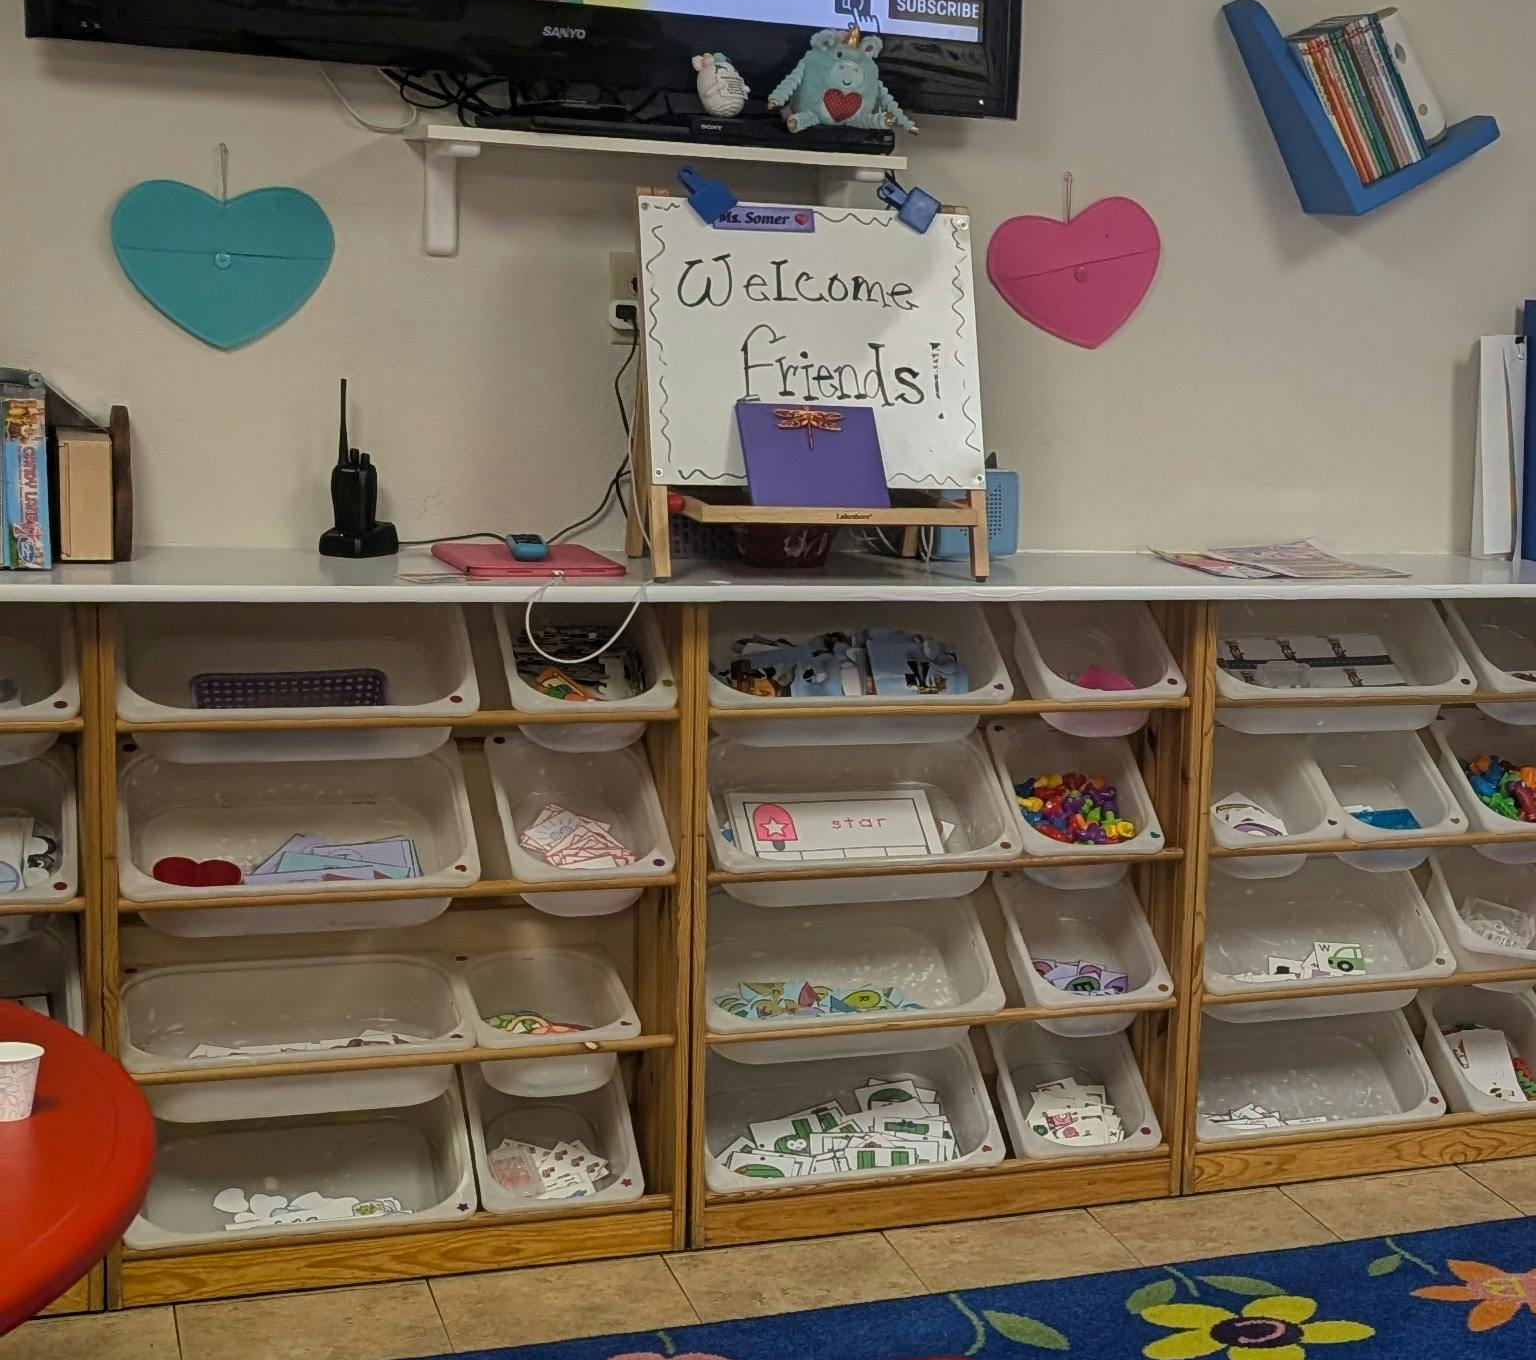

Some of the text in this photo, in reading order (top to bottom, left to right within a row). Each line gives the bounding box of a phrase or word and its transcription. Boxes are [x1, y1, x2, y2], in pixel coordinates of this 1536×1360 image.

[542, 26, 586, 39] SANYO
[744, 211, 790, 226] Somer
[677, 254, 919, 310] Welcome
[832, 817, 887, 829] star
[1235, 1319, 1285, 1344] C
